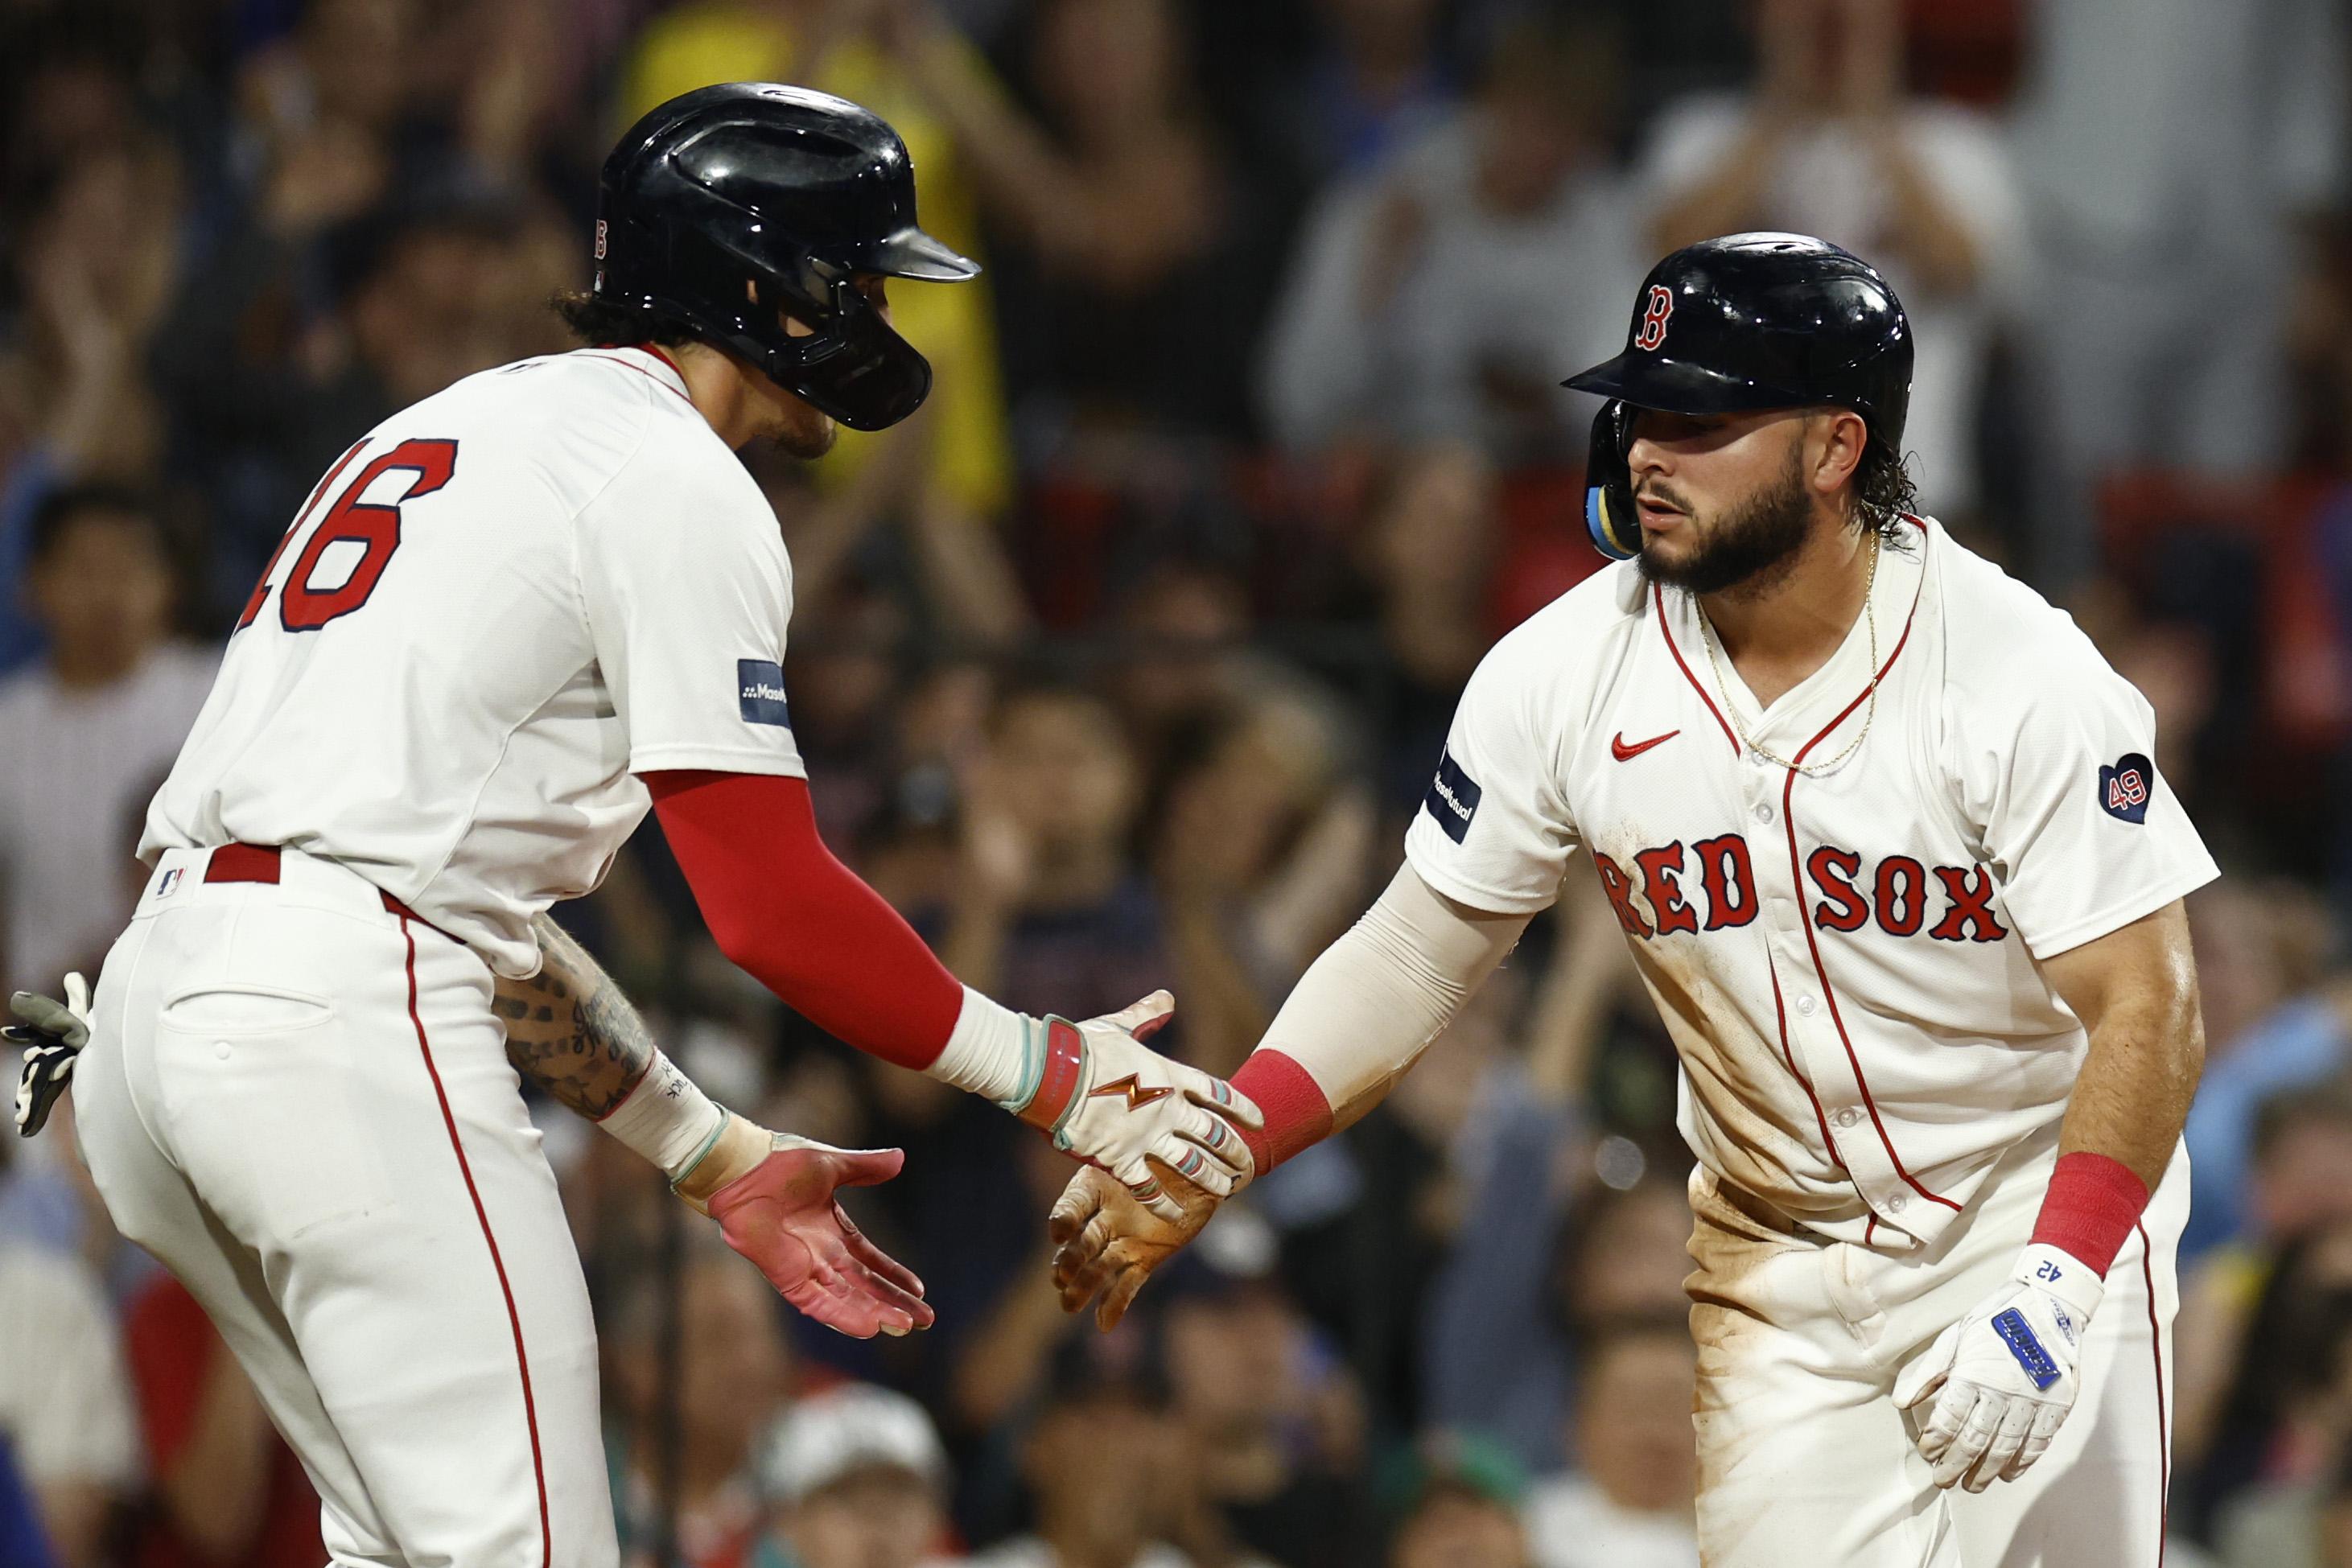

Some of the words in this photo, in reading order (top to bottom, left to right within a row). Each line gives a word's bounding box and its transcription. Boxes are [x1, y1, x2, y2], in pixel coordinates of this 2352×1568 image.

[1634, 284, 1674, 352] B
[2108, 768, 2147, 811] 49
[1592, 833, 1760, 940] RED
[1806, 845, 2008, 942] SOX
[2036, 1260, 2062, 1282] 42
